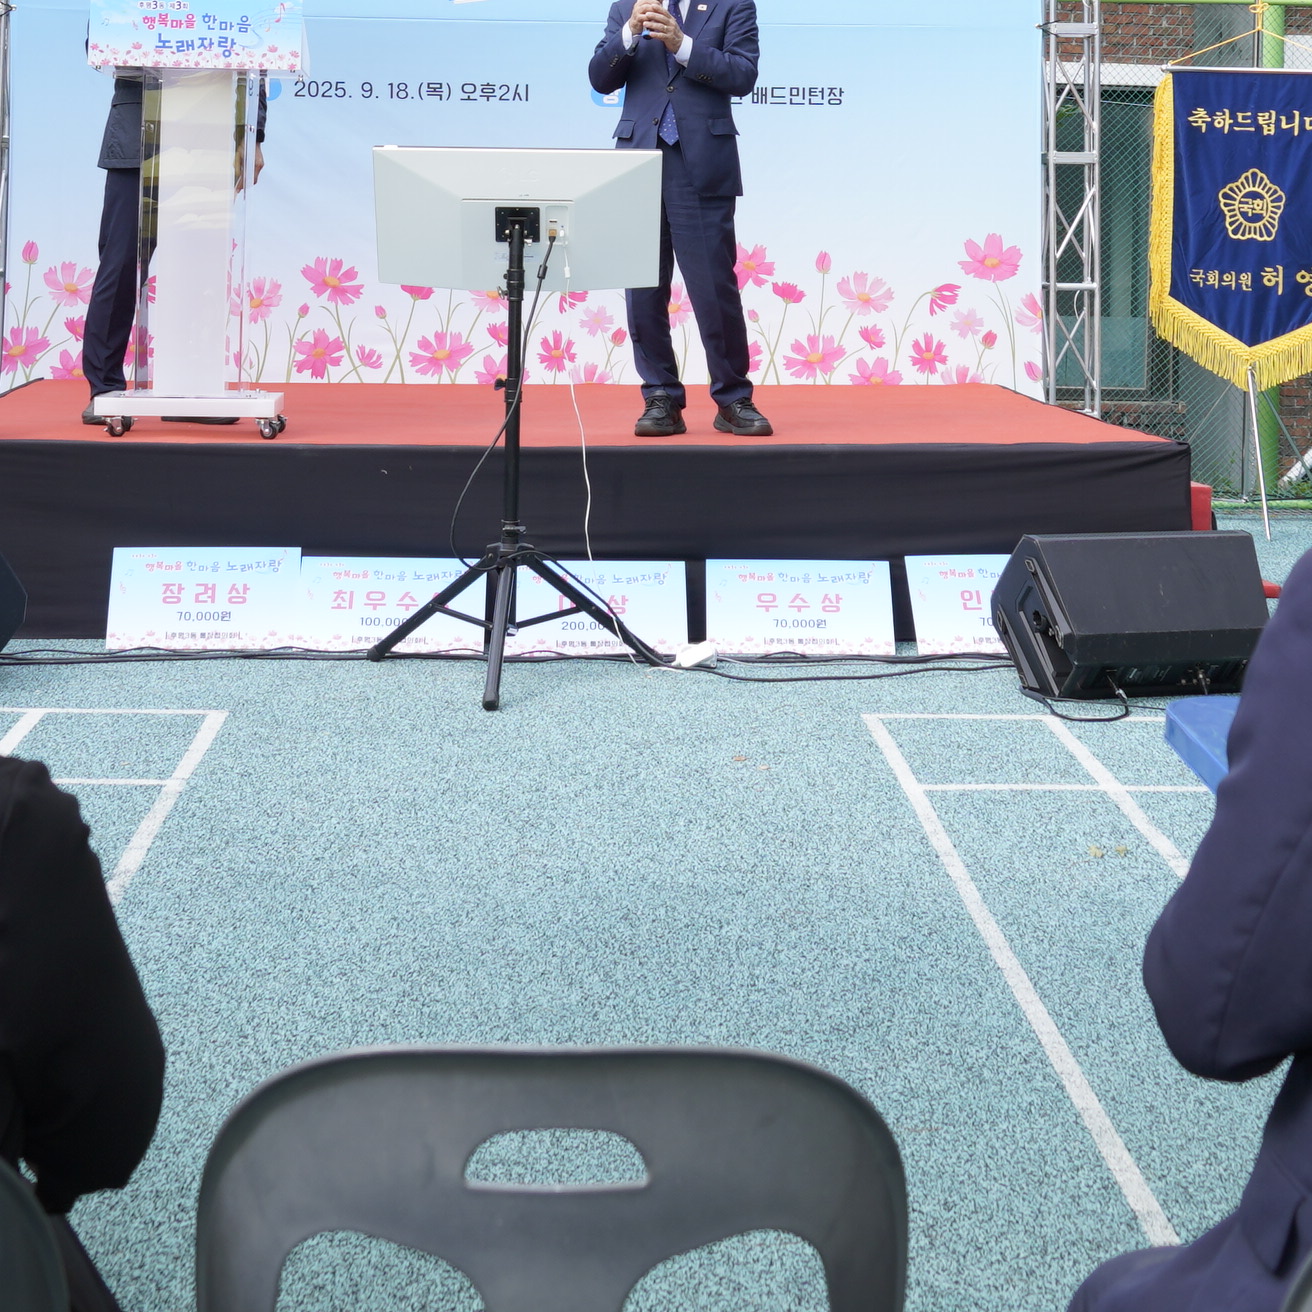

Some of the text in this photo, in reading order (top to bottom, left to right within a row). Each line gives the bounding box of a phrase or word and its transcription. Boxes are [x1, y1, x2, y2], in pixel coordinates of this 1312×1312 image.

[142, 13, 252, 33] 행복마을 한마음
[155, 33, 236, 58] 노래자랑
[294, 80, 352, 99] 2025.
[361, 81, 379, 99] 9.
[460, 83, 529, 102] 오후2시
[751, 86, 845, 106] 배드민턴장
[1239, 198, 1267, 217] 국회
[1189, 268, 1252, 291] 국회의원
[145, 560, 283, 573] 행복마을 한마음 노래자랑
[373, 570, 407, 582] 한마음
[978, 568, 1002, 578] 한마
[613, 572, 667, 585] 노래자랑
[778, 572, 812, 584] 한마음
[817, 571, 871, 584] 노래자랑
[331, 590, 450, 611] 최우수
